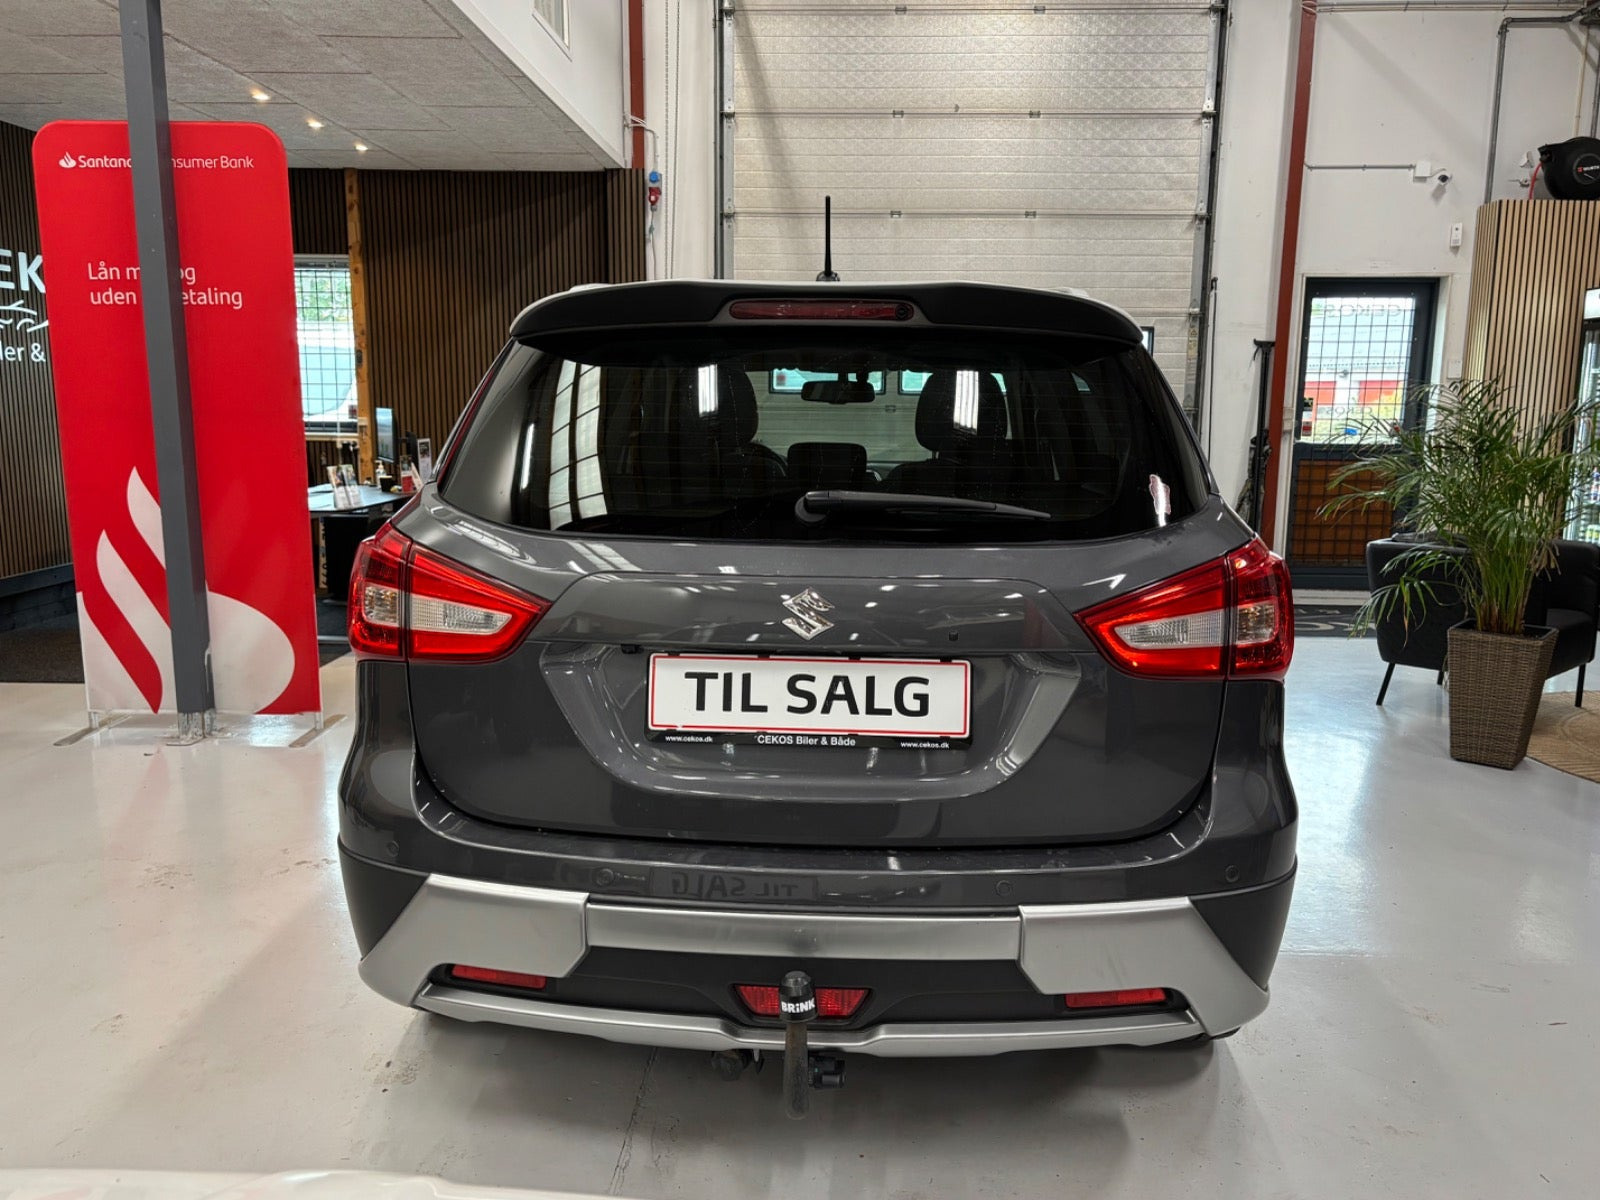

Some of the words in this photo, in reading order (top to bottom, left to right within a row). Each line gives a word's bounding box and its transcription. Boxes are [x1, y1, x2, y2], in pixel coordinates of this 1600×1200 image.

[171, 157, 217, 169] nsumer
[220, 155, 255, 169] Bank
[87, 260, 121, 281] Lån
[90, 287, 137, 305] uden
[182, 287, 243, 310] etaling
[31, 342, 46, 362] &
[684, 671, 769, 713] TIL
[786, 673, 930, 718] SALG
[757, 734, 794, 745] CEKOS
[796, 735, 819, 746] Biler
[820, 736, 829, 746] &
[831, 735, 856, 746] Både
[900, 741, 950, 749] www.cekos.dk
